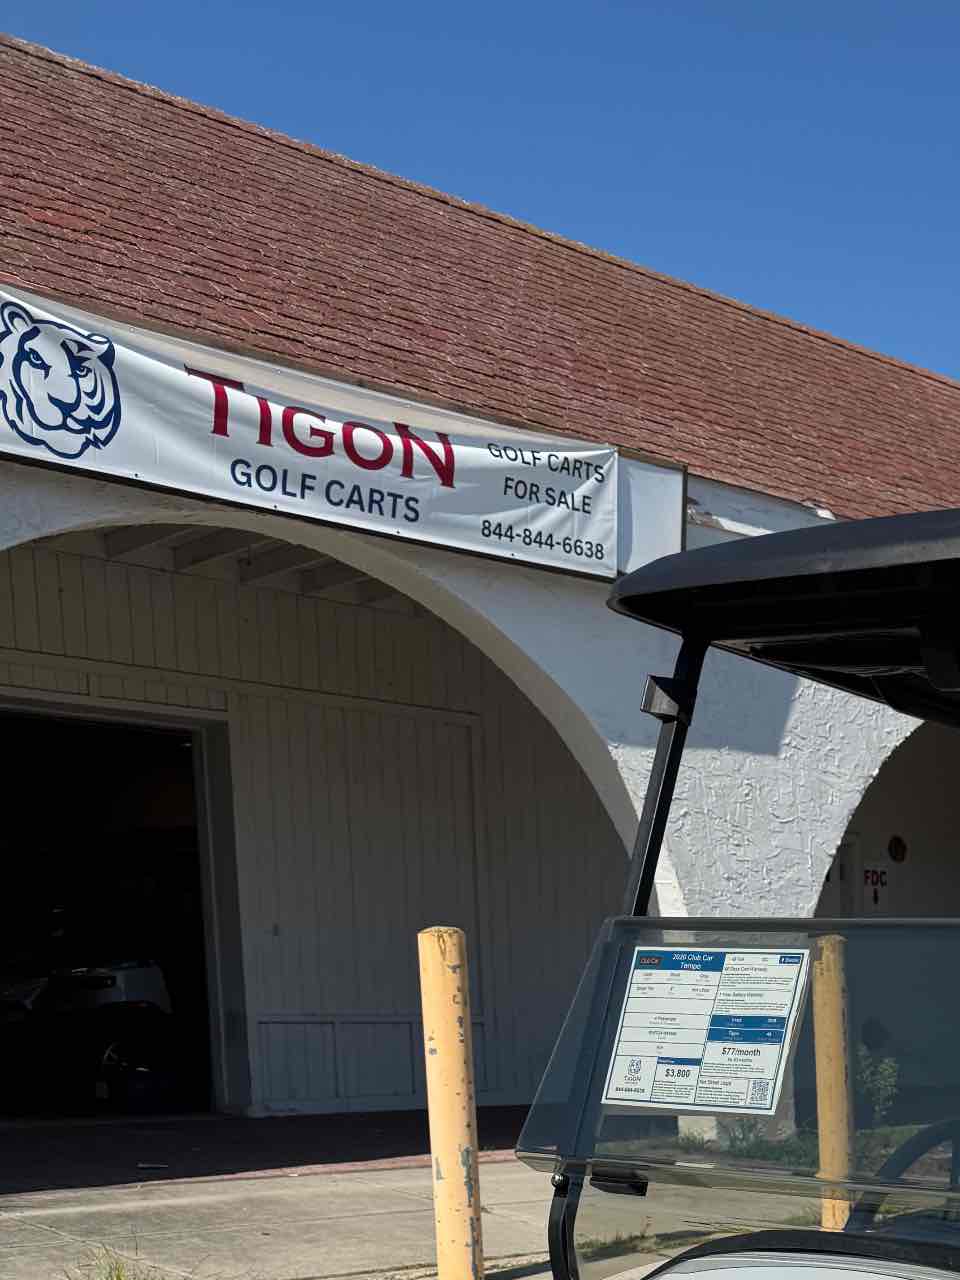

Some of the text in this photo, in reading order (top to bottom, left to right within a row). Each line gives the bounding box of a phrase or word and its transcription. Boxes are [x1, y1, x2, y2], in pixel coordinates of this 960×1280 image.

[184, 364, 456, 489] TIGON
[487, 443, 605, 484] GOLF CARTS
[230, 458, 420, 523] GOLF CARTS
[503, 476, 593, 515] FOR SALE
[481, 519, 605, 561] 844-844-6638
[864, 869, 888, 888] FDC
[680, 962, 702, 971] Tempo
[687, 953, 702, 961] Club
[702, 954, 714, 962] Car
[720, 1047, 761, 1057] $77/month
[664, 1068, 691, 1079] $3,800
